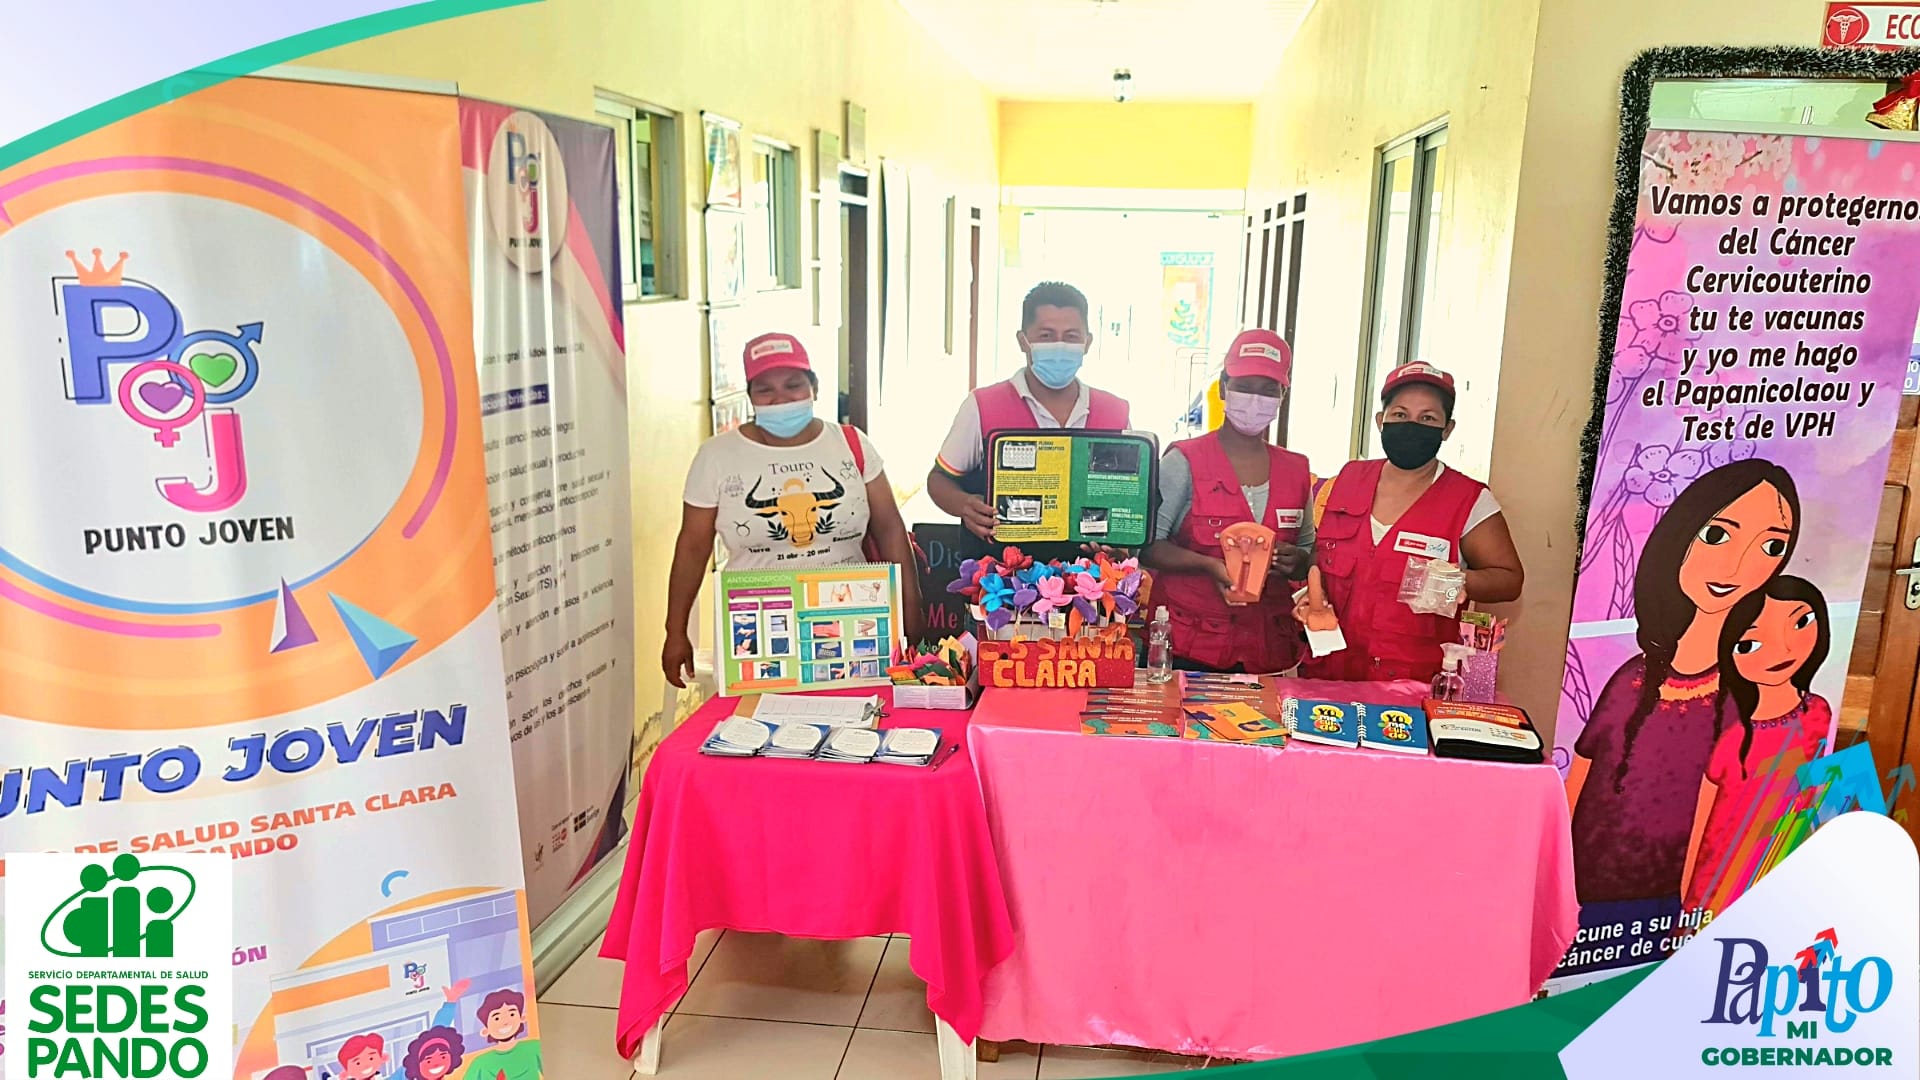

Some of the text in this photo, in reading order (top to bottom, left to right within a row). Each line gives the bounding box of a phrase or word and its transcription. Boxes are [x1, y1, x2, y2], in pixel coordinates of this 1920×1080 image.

[1651, 186, 1920, 226] Vamos a protegerno
[1719, 227, 1855, 256] del Cáncer
[1686, 266, 1871, 293] Cervicouterino
[1689, 306, 1864, 331] tu te vacunas
[1680, 341, 1857, 375] y yo me hago
[1642, 377, 1875, 411] el Papanicolaou y
[1683, 412, 1836, 441] Test de VPH
[768, 460, 814, 476] Touro
[84, 516, 295, 555] PUNTO JOVEN
[1038, 635, 1133, 661] SANTA
[993, 659, 1096, 688] CLARA
[222, 704, 468, 783] JOVEN
[130, 820, 240, 852] SALUD
[251, 801, 356, 834] SANTA
[365, 782, 457, 813] CLARA
[1575, 907, 1714, 943] cune a su hija
[1557, 944, 1624, 968] cáncer
[1631, 938, 1652, 957] de
